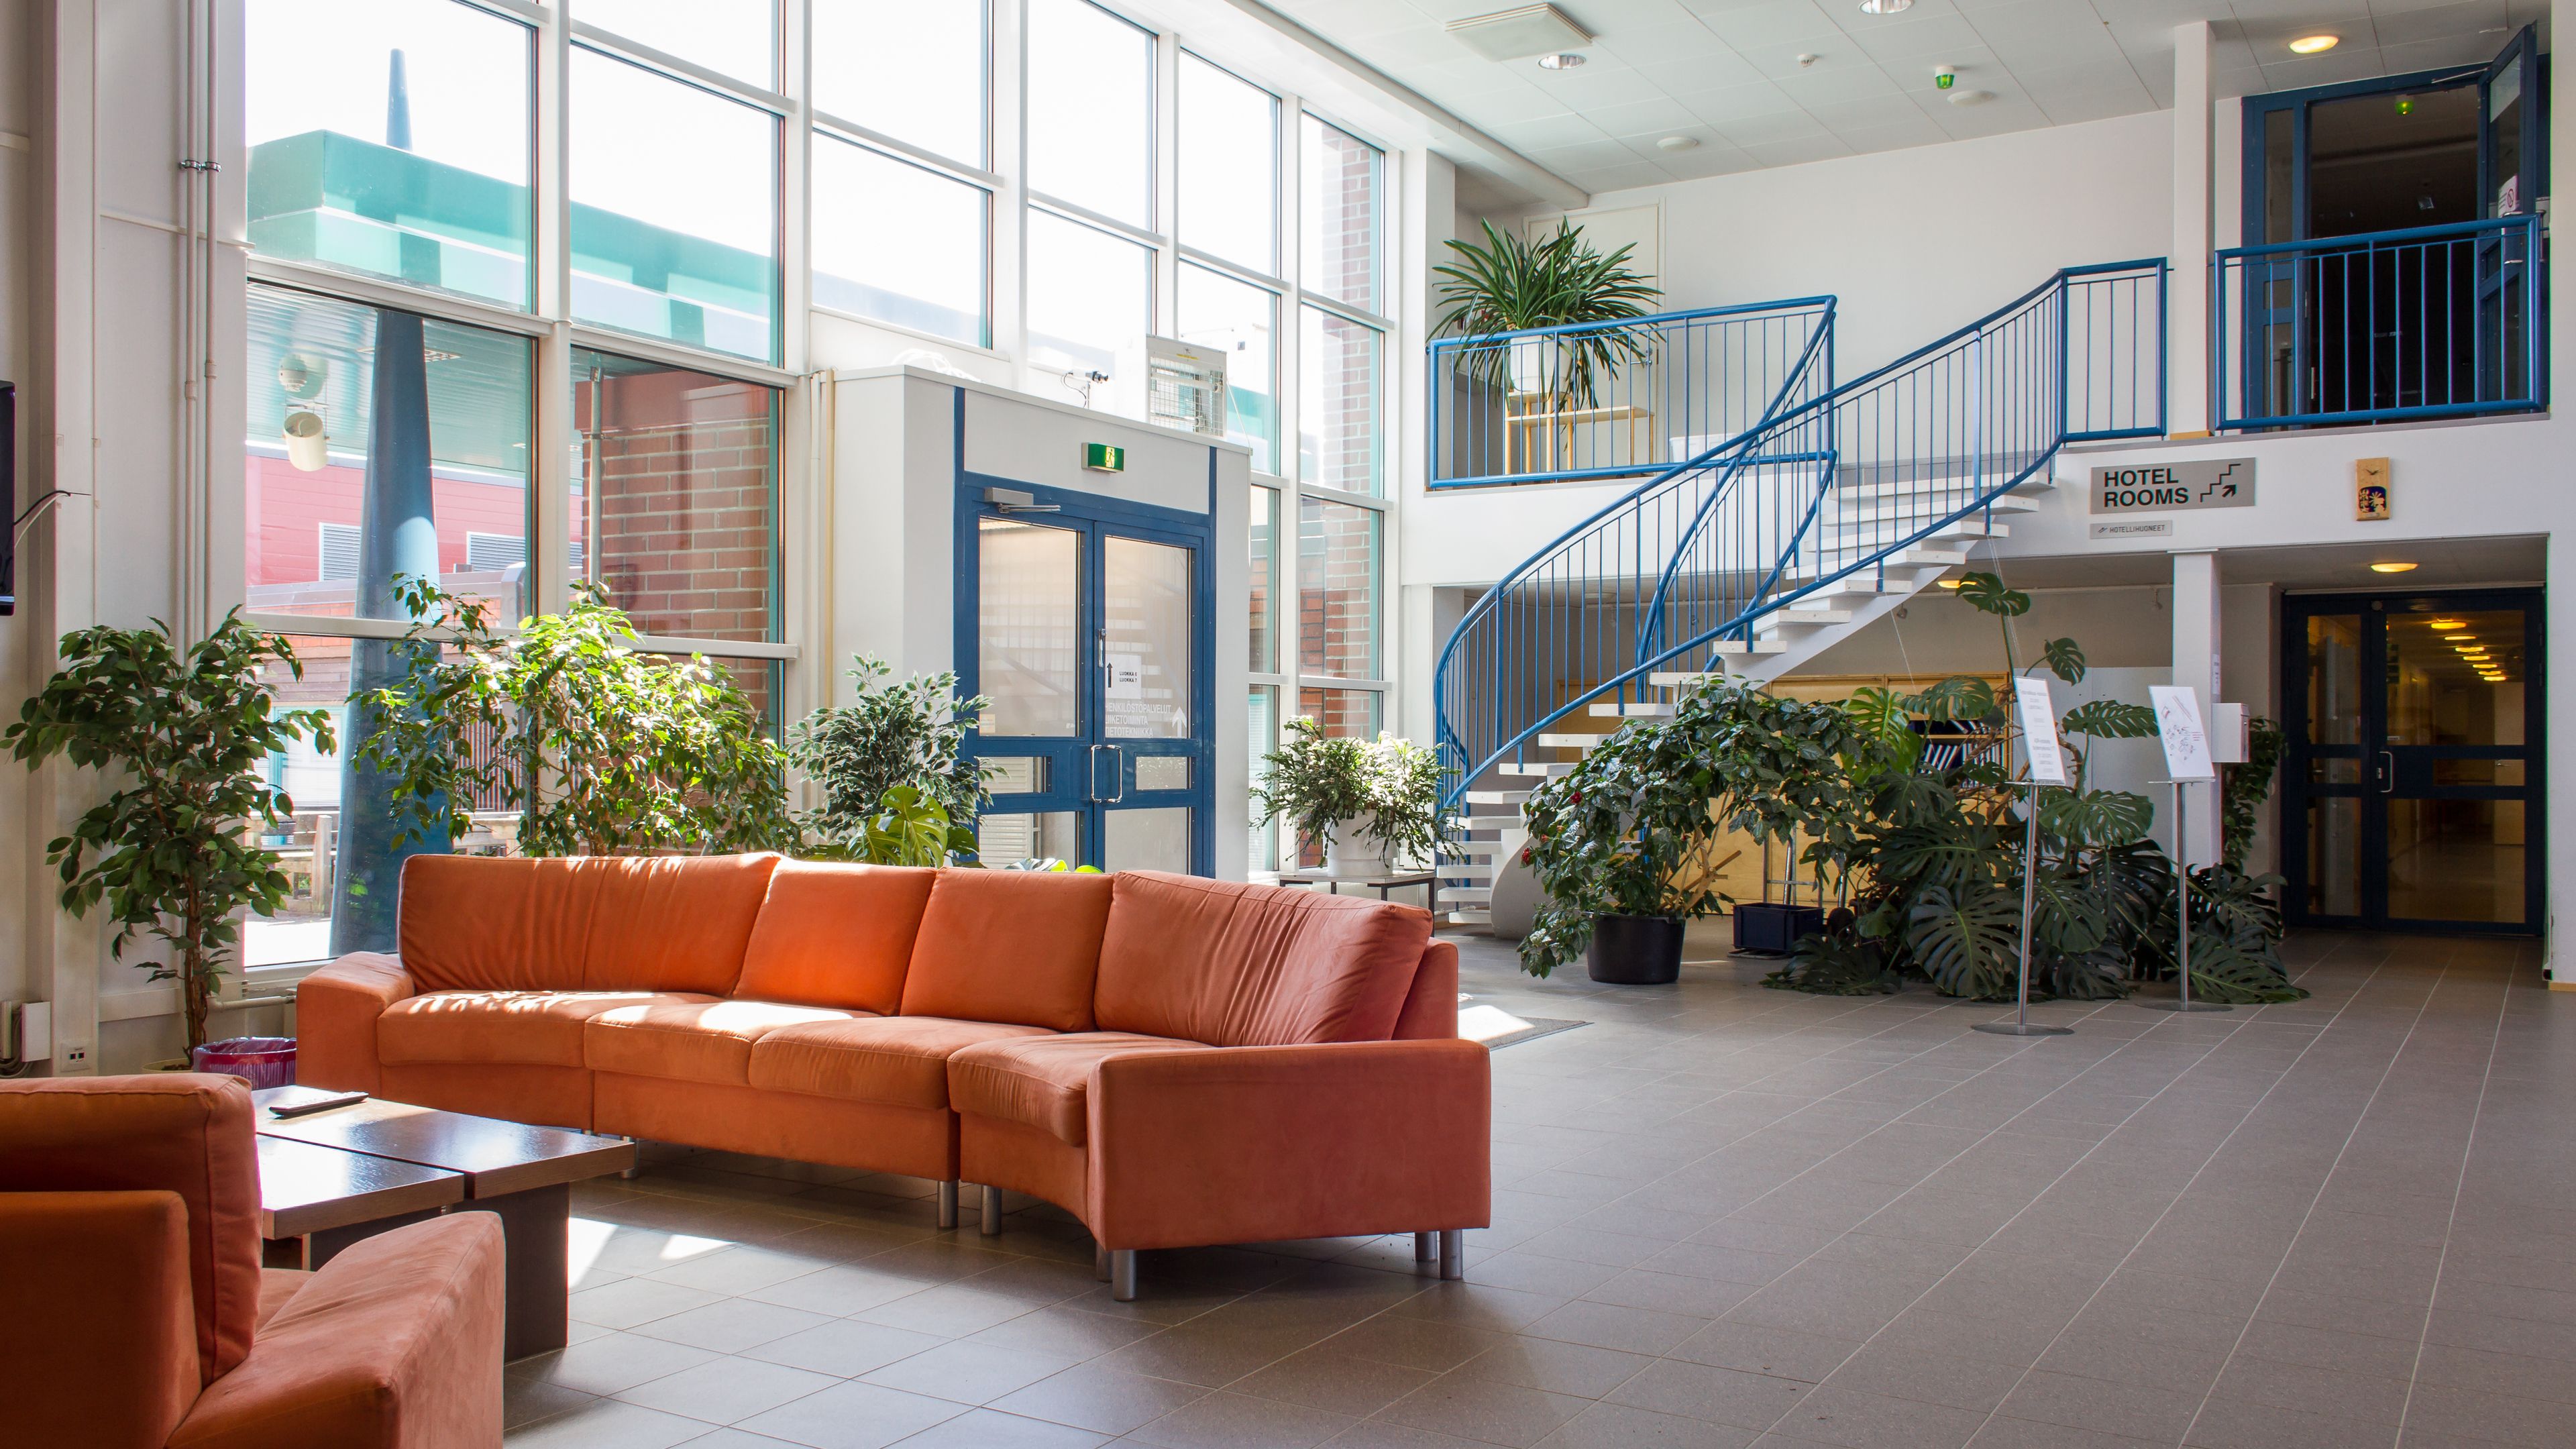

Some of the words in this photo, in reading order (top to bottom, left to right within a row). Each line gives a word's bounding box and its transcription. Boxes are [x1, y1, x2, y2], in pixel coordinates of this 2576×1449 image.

[2104, 468, 2178, 487] HOTEL
[2104, 488, 2189, 507] ROOMS
[2109, 525, 2165, 533] HOTELLIHUONEET
